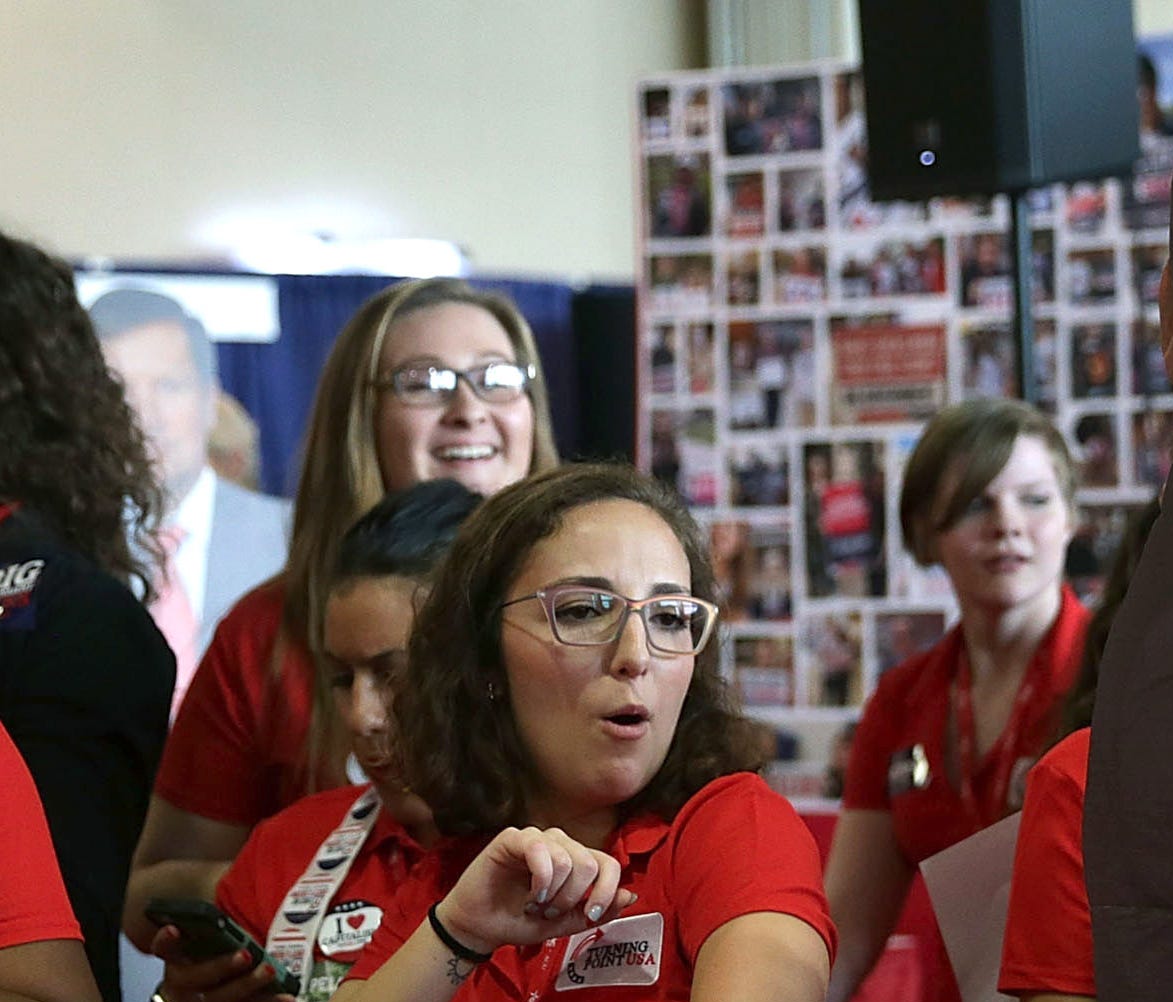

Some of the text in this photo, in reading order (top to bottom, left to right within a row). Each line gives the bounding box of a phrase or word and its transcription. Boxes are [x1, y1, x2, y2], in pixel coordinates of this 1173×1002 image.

[0, 559, 45, 588] IG
[583, 952, 656, 971] POINT USA
[587, 940, 649, 962] TURNING
